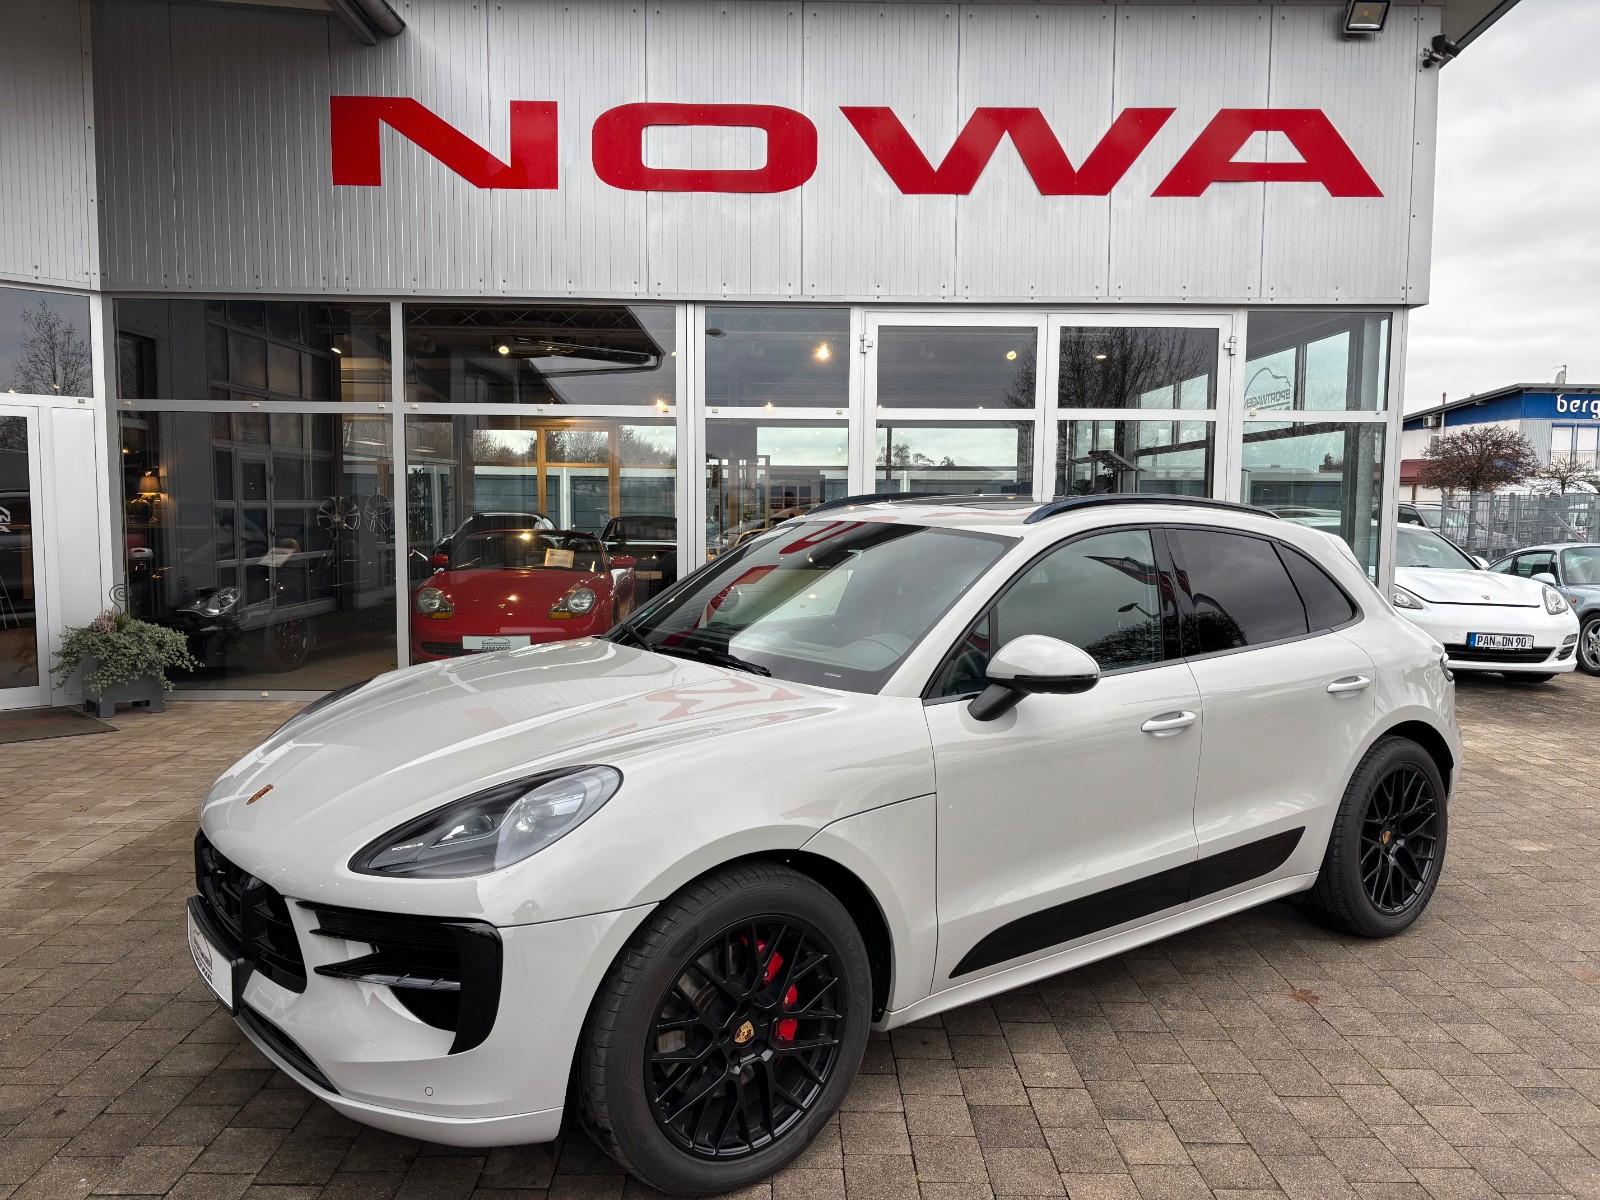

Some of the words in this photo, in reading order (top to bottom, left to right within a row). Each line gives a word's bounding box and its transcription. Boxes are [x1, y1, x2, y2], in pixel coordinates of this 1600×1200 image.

[331, 96, 1383, 198] NOWA
[1556, 394, 1600, 419] berg
[1477, 635, 1496, 646] PAN
[1501, 636, 1514, 647] DN
[1515, 637, 1527, 648] 90
